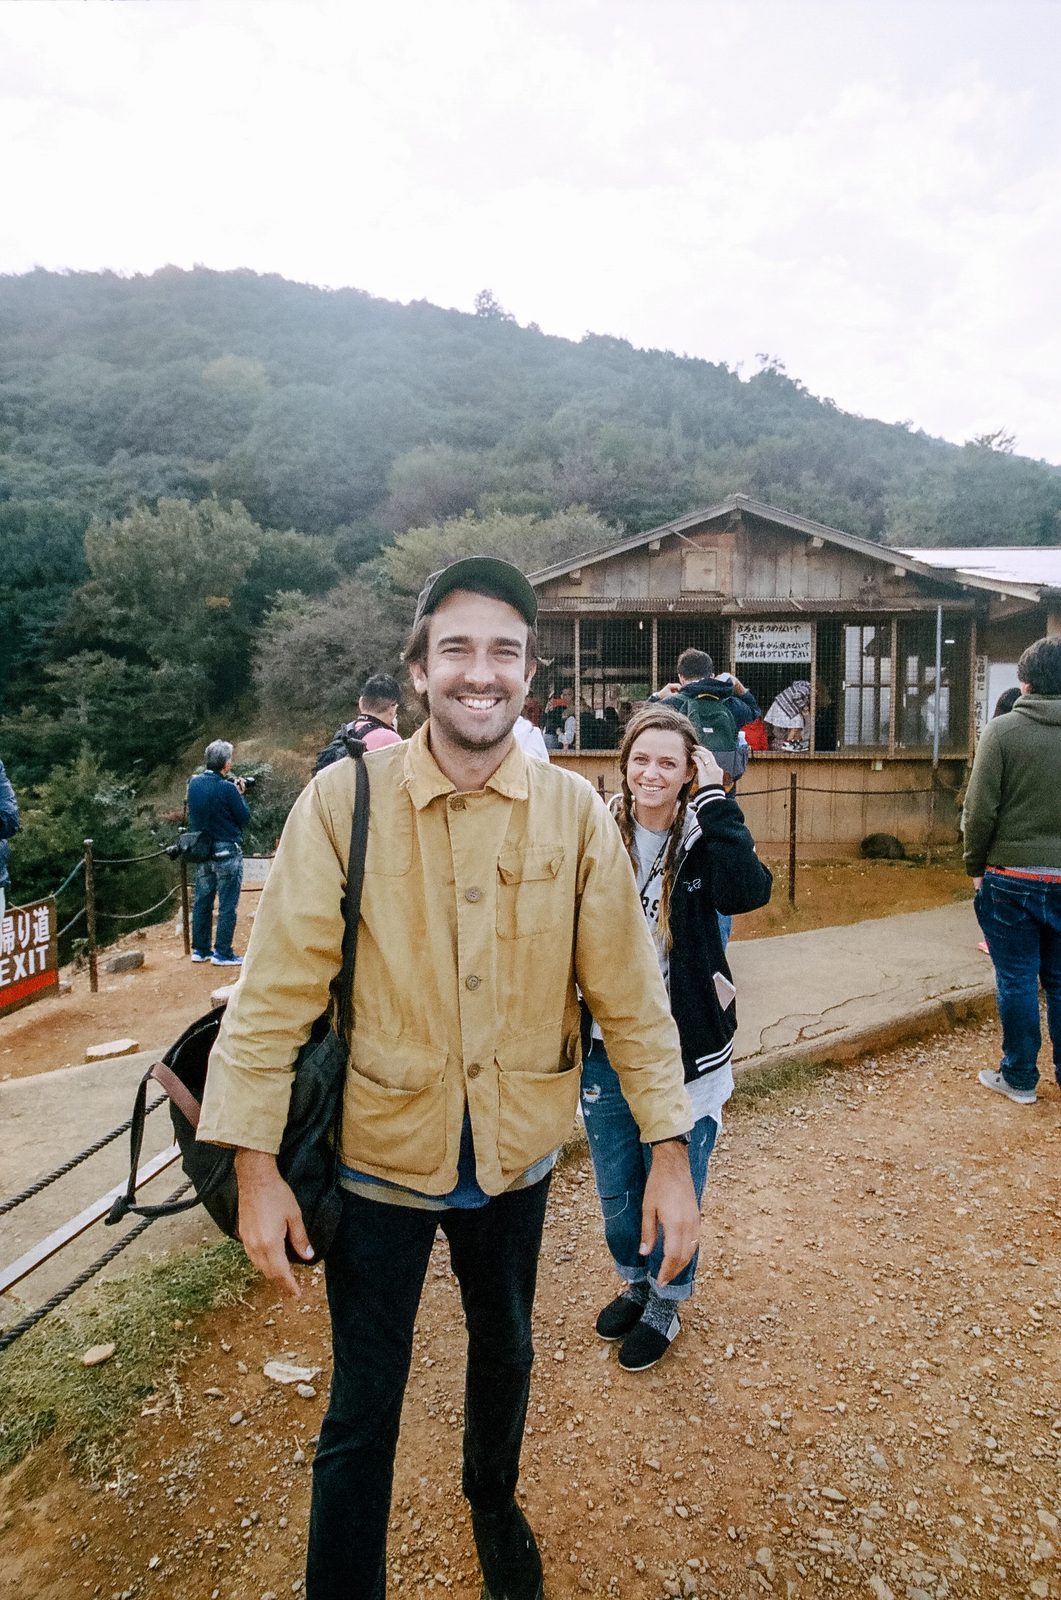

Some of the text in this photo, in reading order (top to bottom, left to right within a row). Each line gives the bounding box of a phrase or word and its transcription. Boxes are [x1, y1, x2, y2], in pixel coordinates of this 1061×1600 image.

[0, 905, 50, 956] 帰り道
[0, 944, 49, 988] EXIT
